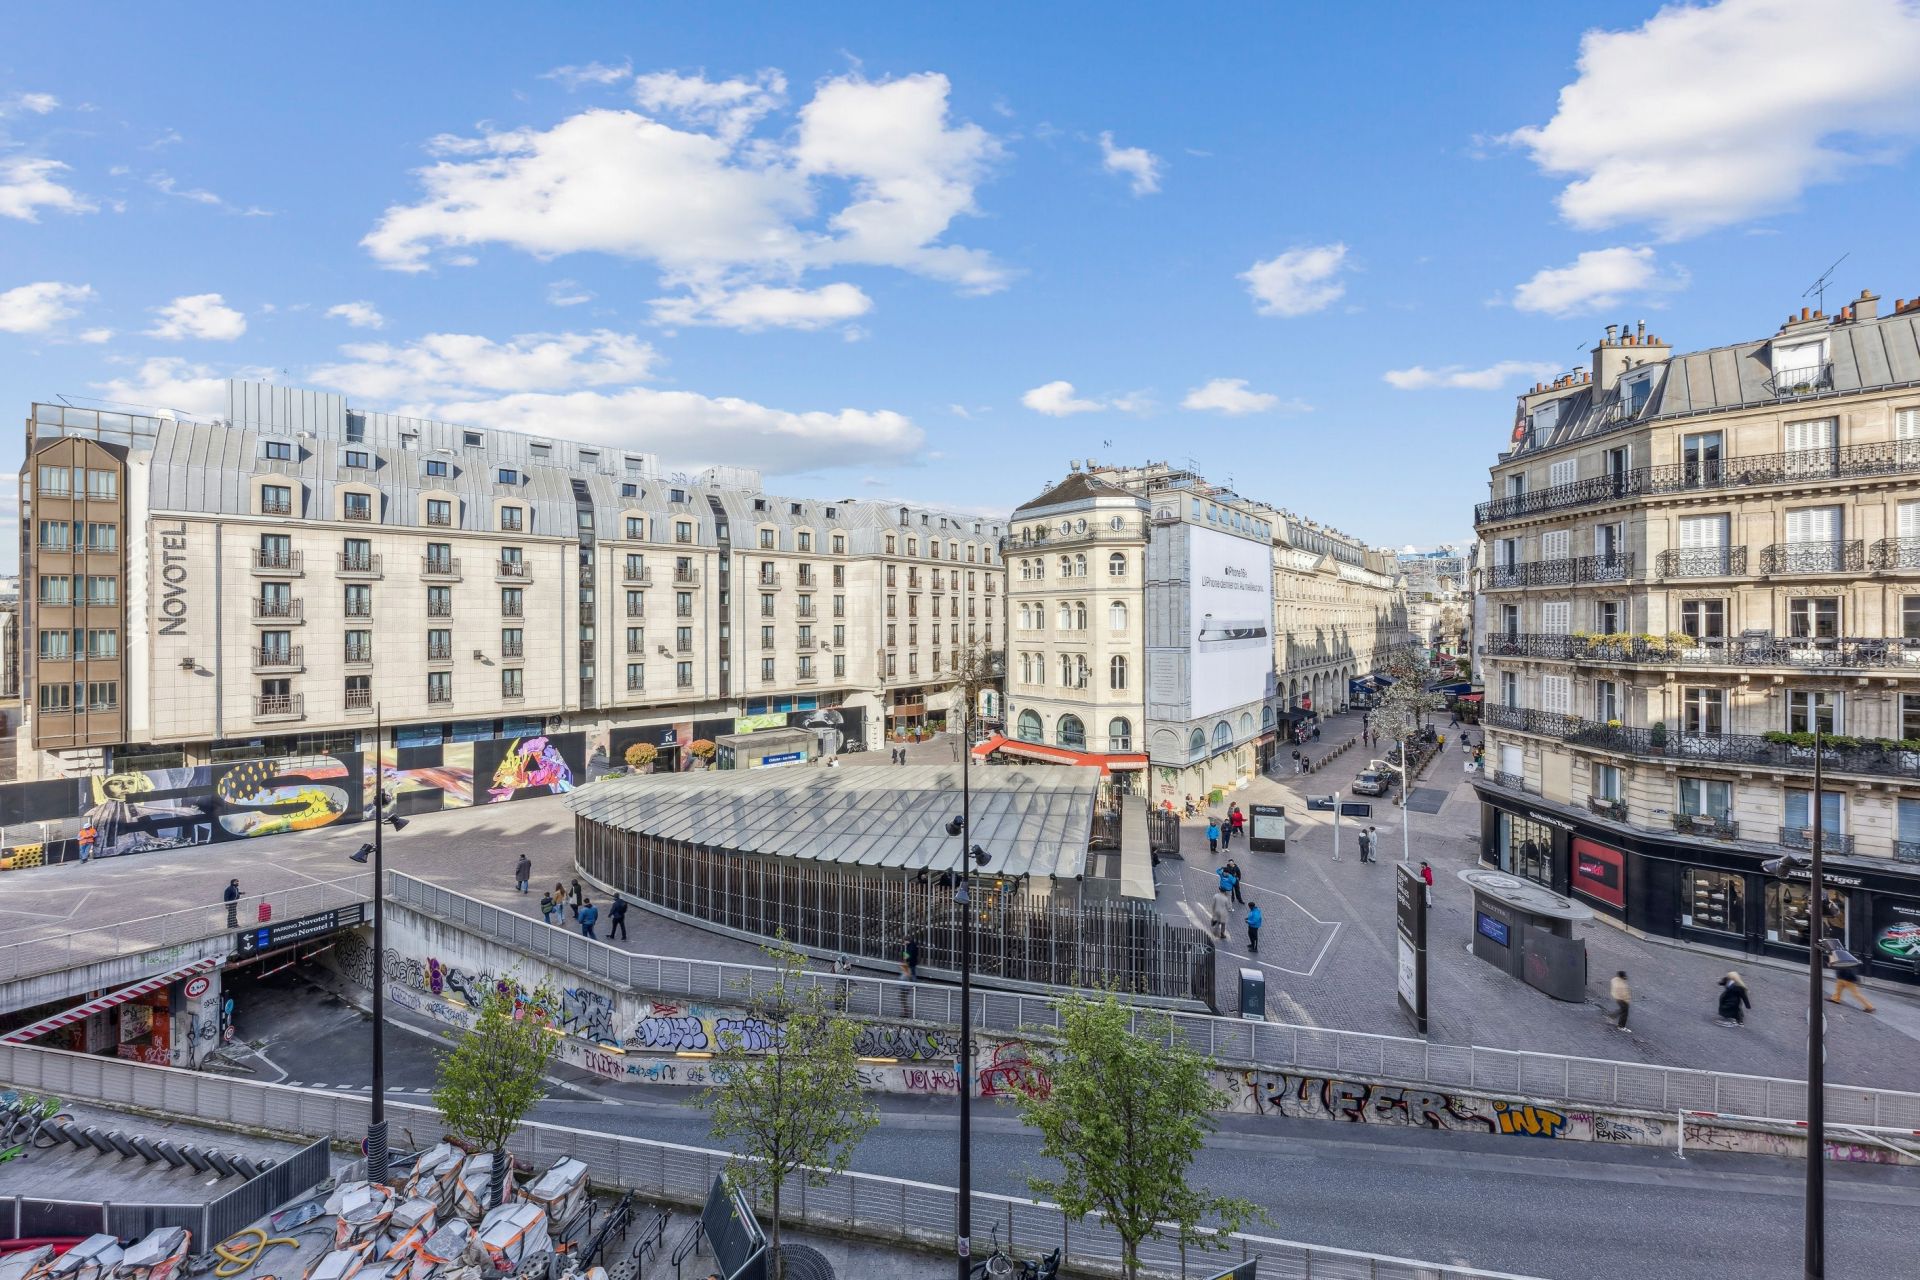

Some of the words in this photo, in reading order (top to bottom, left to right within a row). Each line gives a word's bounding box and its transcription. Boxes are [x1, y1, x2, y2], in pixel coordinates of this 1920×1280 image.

[158, 520, 187, 635] NOVOTEL
[1823, 873, 1862, 885] Tiger
[273, 923, 298, 933] PARKING
[298, 914, 328, 927] Novotel
[273, 932, 298, 942] PARKING
[298, 922, 328, 936] Novotel
